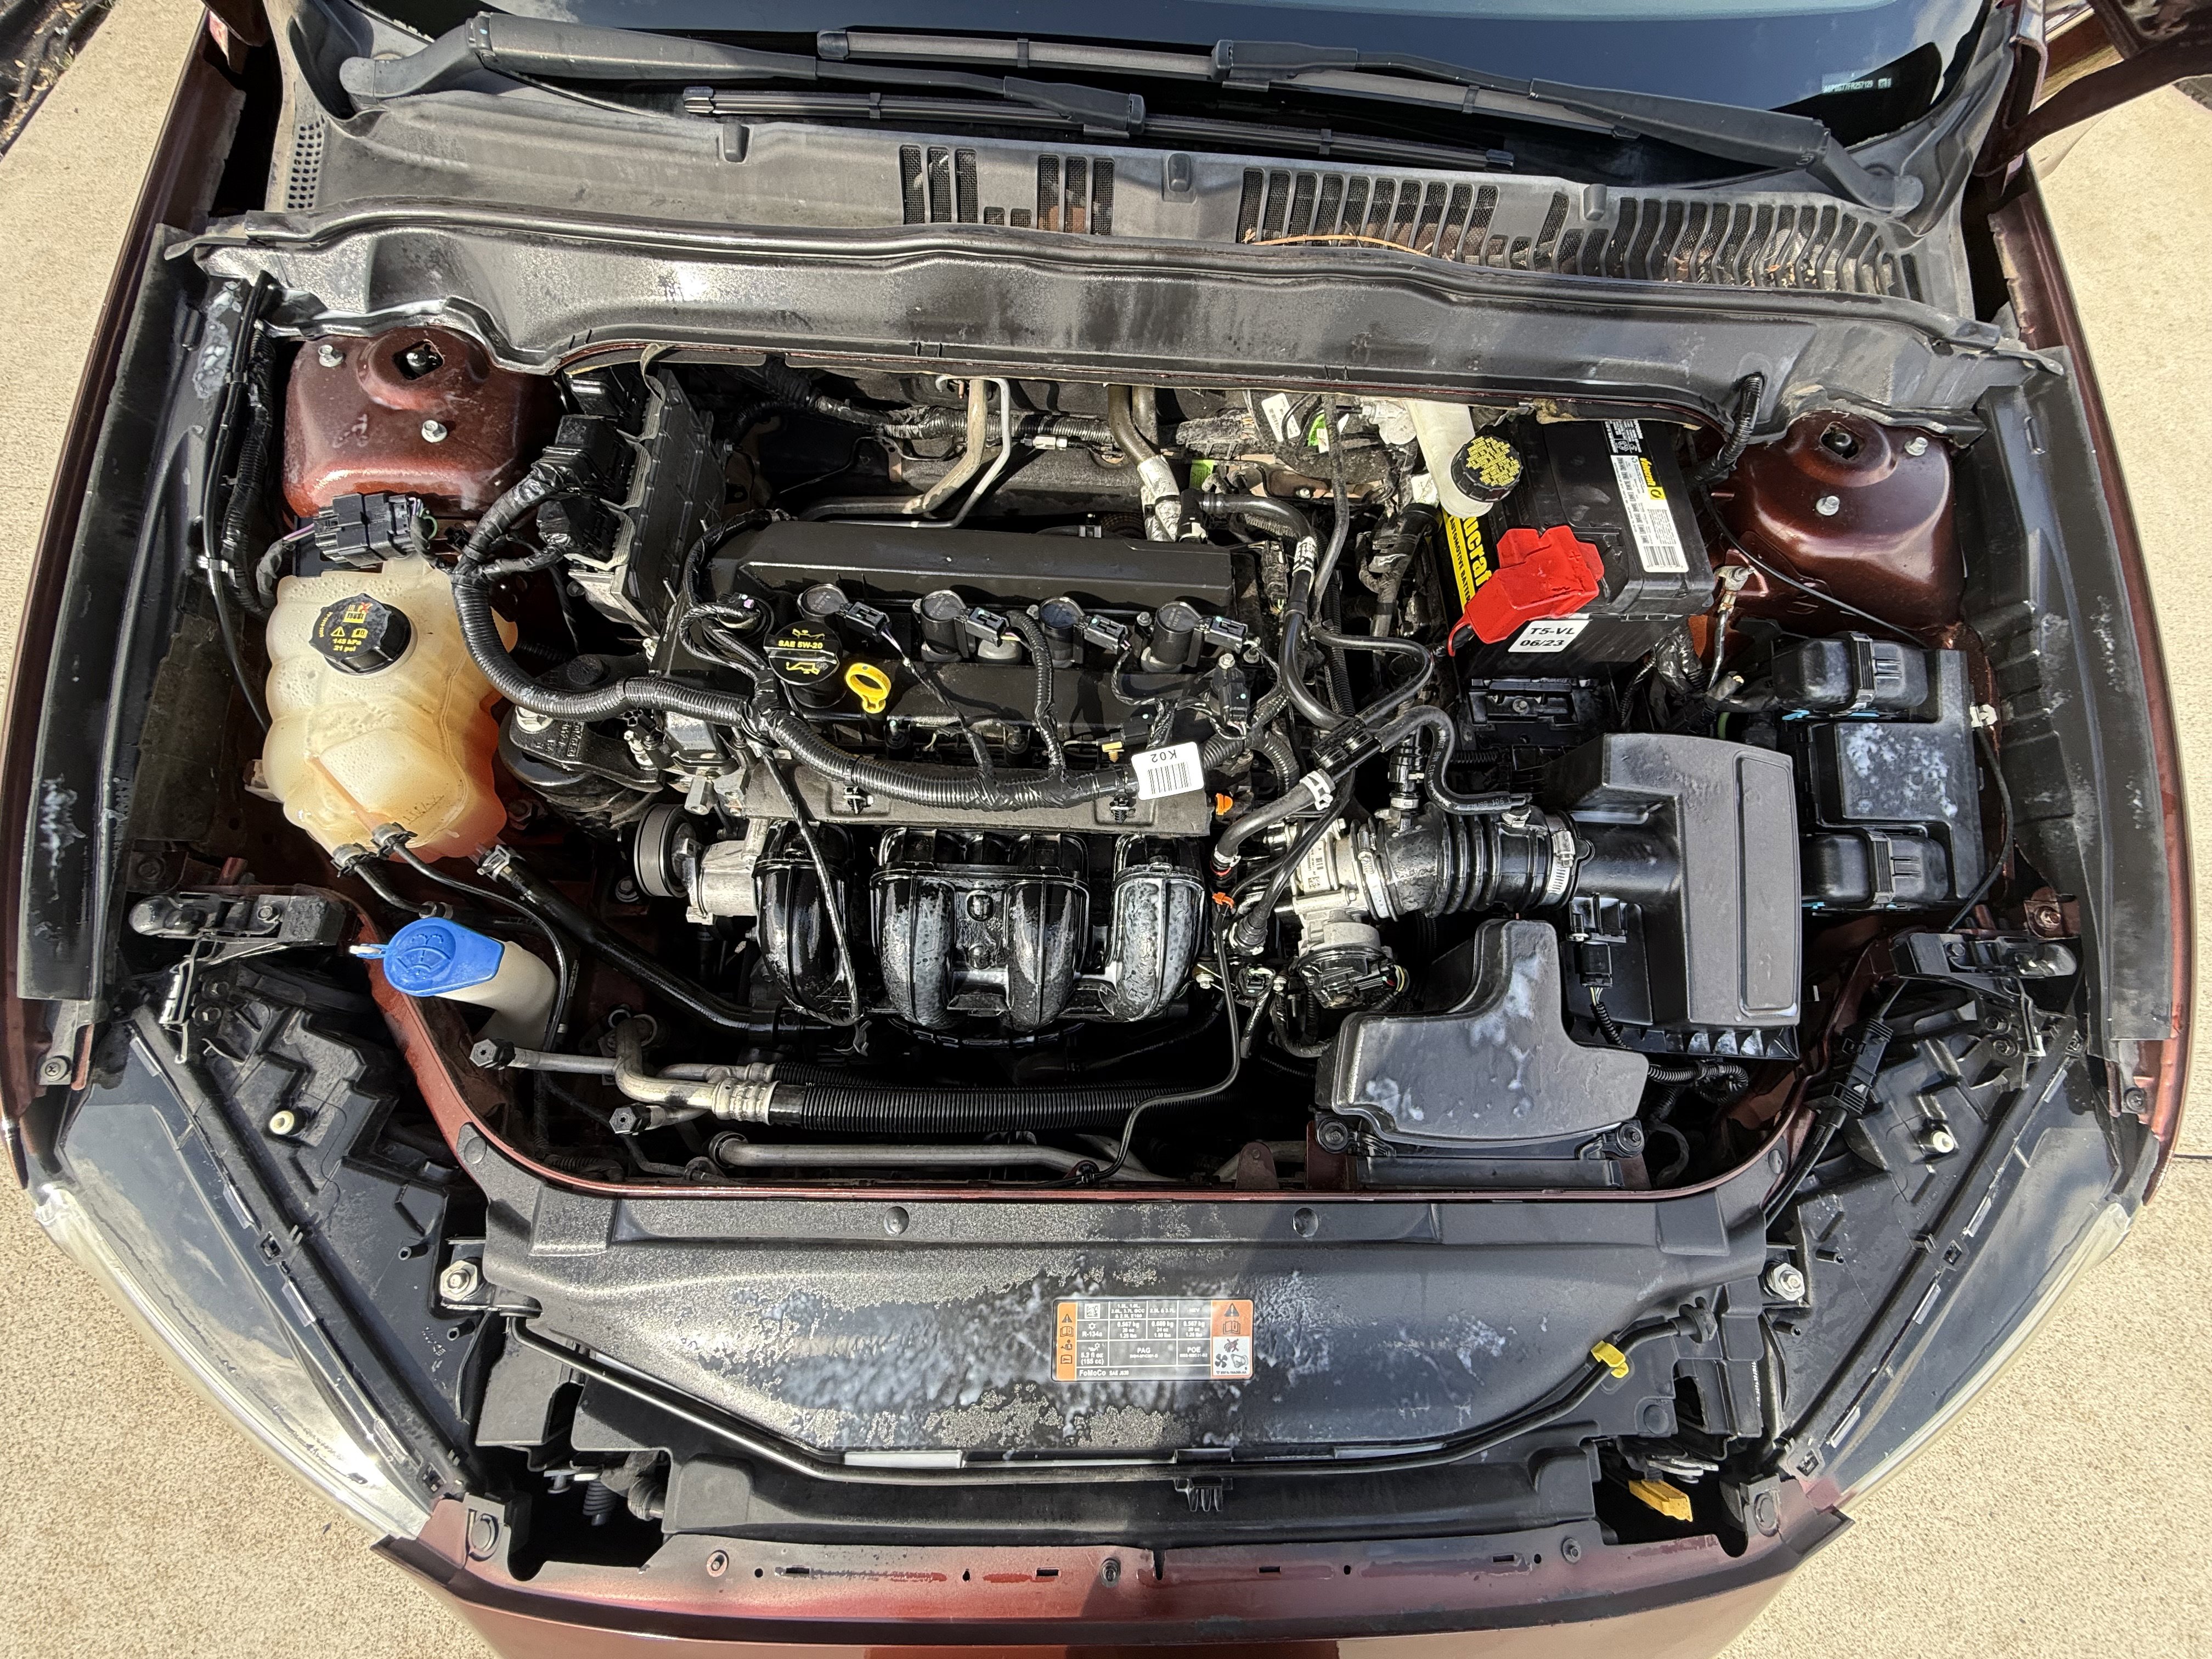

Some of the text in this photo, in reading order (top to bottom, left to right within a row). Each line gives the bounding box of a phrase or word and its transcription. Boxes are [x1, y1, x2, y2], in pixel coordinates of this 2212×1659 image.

[1449, 517, 1471, 603] AUTOMOTIVE BATTER
[1462, 517, 1492, 586] ucraf
[797, 641, 823, 649] 5W-20
[1150, 749, 1177, 763] K02
